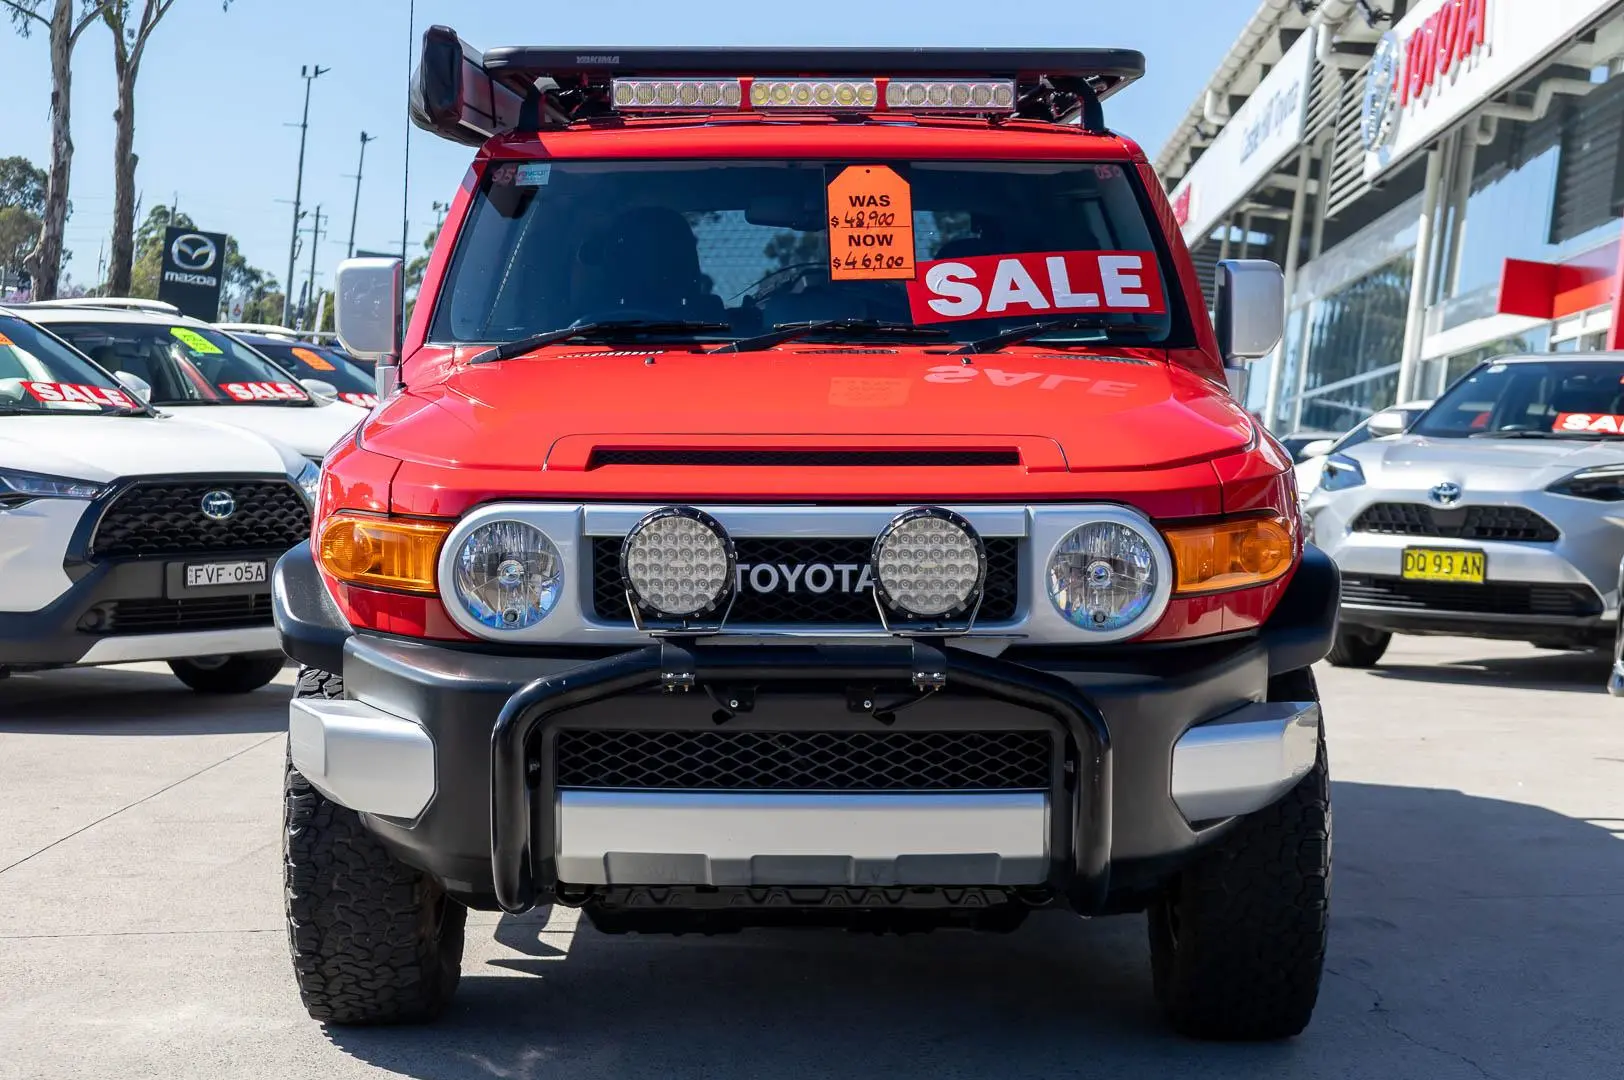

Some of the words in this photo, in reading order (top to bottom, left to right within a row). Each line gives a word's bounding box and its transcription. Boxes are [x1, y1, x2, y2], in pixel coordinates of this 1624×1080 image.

[1400, 0, 1486, 108] TOYOTA
[849, 194, 891, 208] WAS
[848, 233, 894, 247] NOW
[164, 270, 217, 287] mazda
[925, 255, 1150, 317] SALE
[31, 381, 133, 409] SALE
[227, 383, 305, 400] SALE
[1433, 554, 1454, 574] 93
[1460, 555, 1482, 576] AN
[735, 563, 875, 593] TOYOTA
